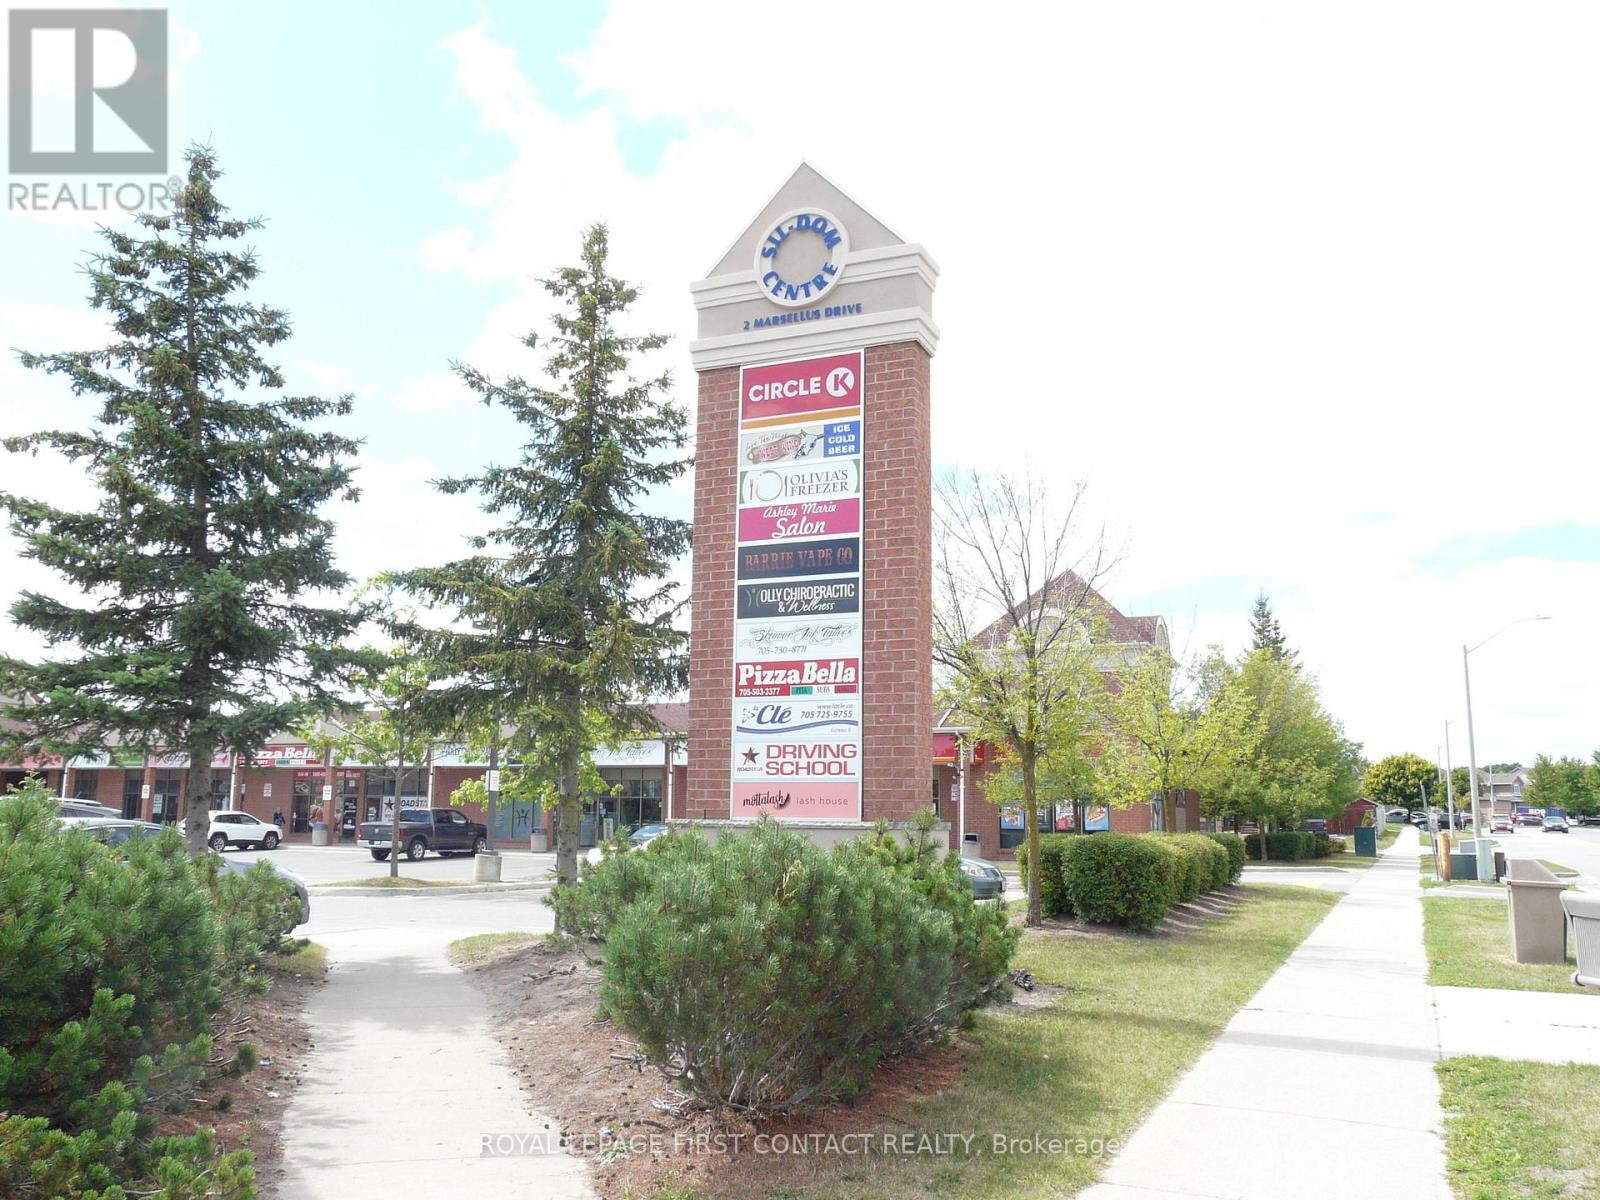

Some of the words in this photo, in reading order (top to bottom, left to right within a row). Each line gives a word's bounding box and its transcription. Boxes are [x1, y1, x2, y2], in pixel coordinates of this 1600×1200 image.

[761, 214, 842, 259] SIL-DOM
[763, 262, 838, 301] CENTRE
[743, 320, 750, 330] 2
[753, 309, 821, 328] MARSELLUS
[825, 303, 862, 317] DRIVE
[748, 376, 822, 402] CIRCLE
[828, 369, 854, 396] K
[833, 424, 851, 433] ICE
[828, 434, 855, 444] COLD
[828, 444, 855, 455] BEER
[790, 469, 848, 485] OLIVIA'S
[790, 481, 849, 496] FREEZER
[763, 506, 798, 519] Ashley
[801, 502, 837, 514] Marie
[771, 516, 826, 538] Salon
[798, 547, 833, 568] VAPE
[783, 584, 855, 601] CHIROPRACTIC
[778, 601, 785, 613] &
[786, 598, 835, 612] Wellness
[801, 710, 815, 719] 705
[816, 710, 853, 719] 725-9755
[766, 744, 857, 759] DRIVING
[765, 761, 856, 776] SCHOOL
[796, 796, 816, 805] lash
[819, 796, 849, 806] house
